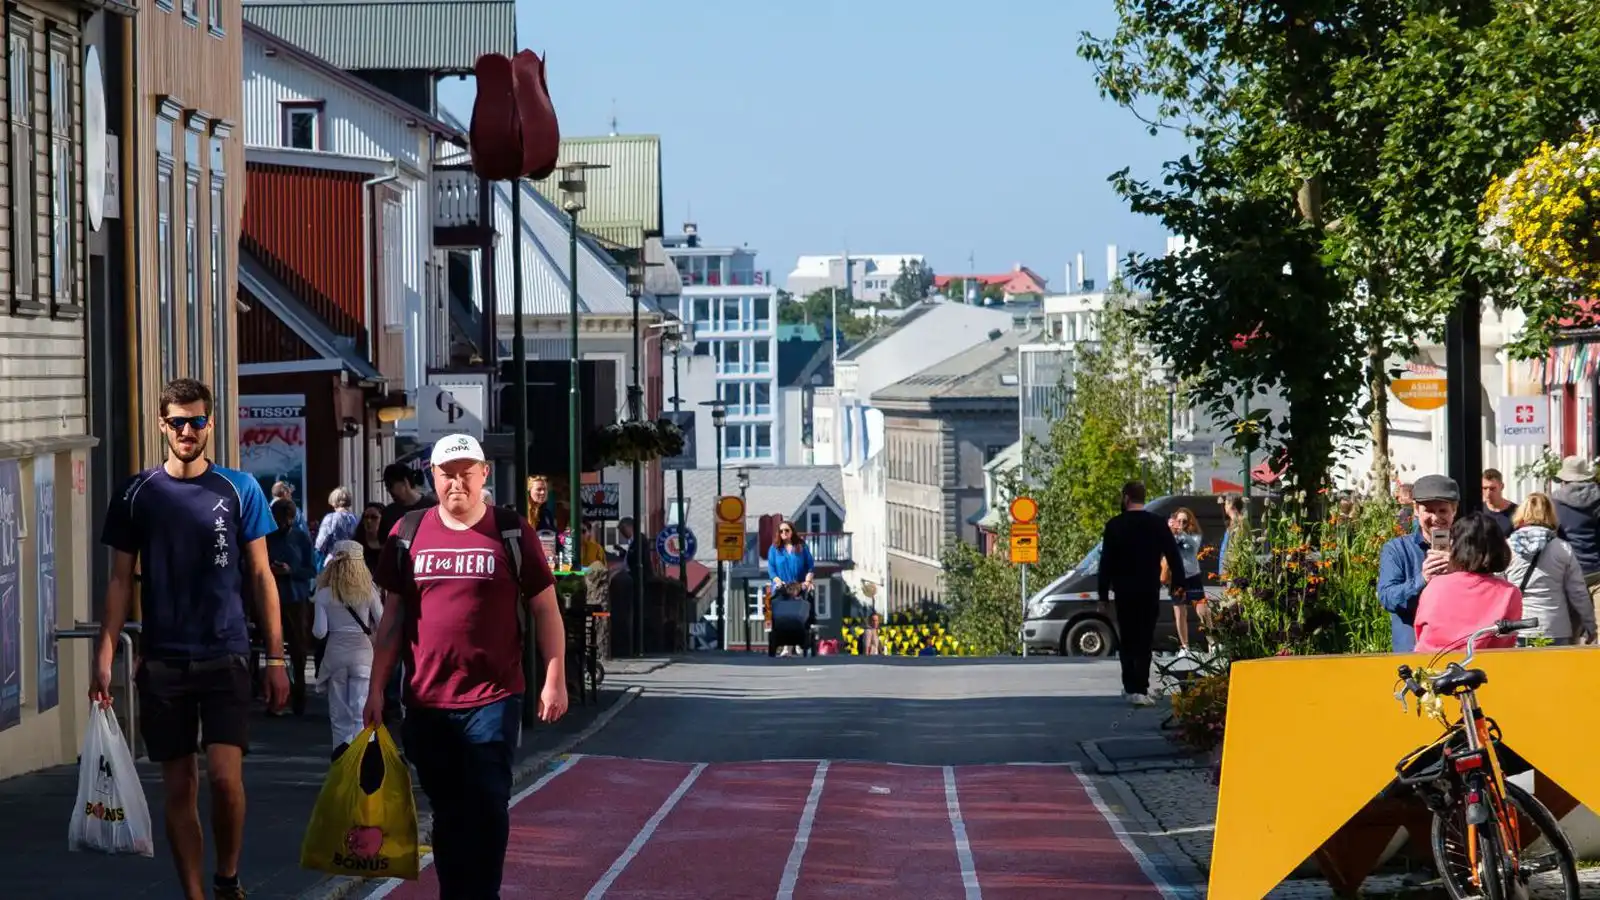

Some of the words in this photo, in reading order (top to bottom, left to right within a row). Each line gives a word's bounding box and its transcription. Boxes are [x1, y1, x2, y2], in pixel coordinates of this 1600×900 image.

[251, 407, 302, 417] TISSOT
[1504, 424, 1545, 435] icemart
[445, 445, 470, 454] COPA
[414, 554, 434, 574] ME
[435, 557, 453, 570] vs
[455, 554, 495, 574] HERO
